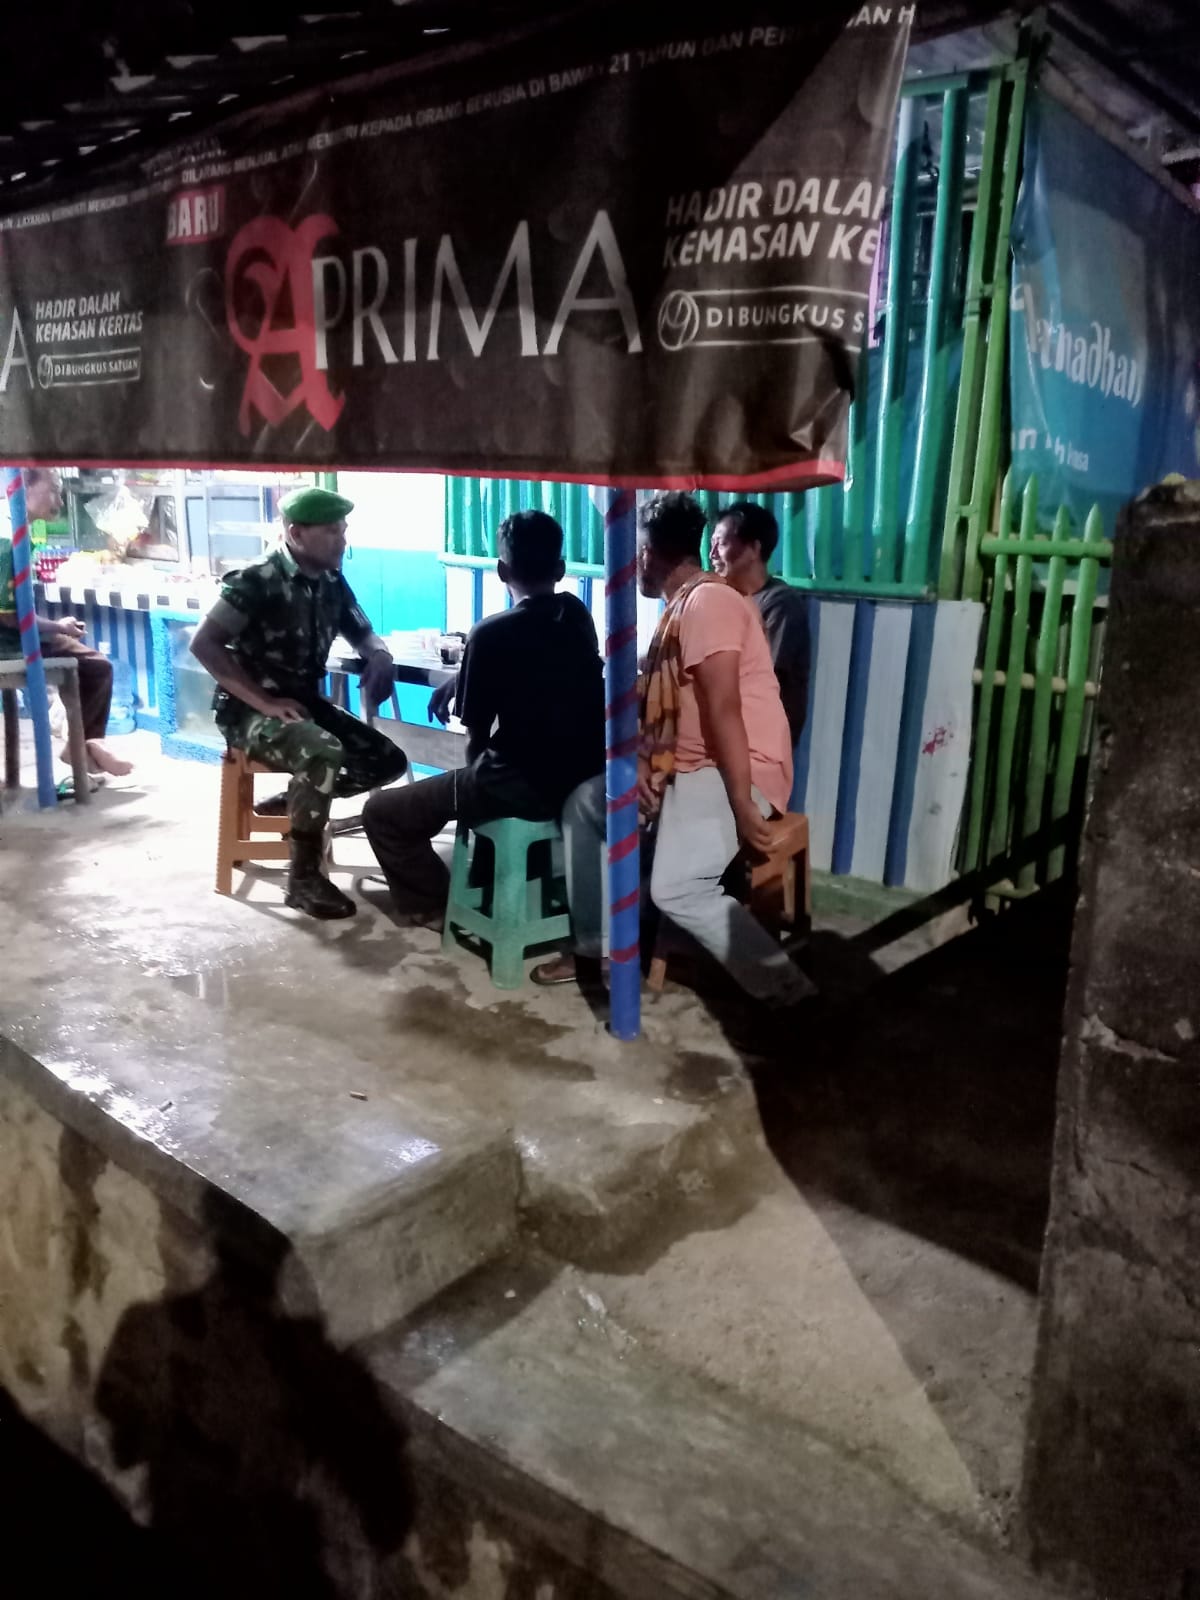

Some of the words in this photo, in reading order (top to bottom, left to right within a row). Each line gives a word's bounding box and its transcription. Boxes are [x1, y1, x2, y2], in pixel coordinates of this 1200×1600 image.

[360, 113, 413, 137] KEPADA
[529, 77, 546, 98] DI
[609, 52, 631, 74] 21
[168, 191, 219, 240] BARU
[666, 181, 763, 225] HADIR
[662, 221, 821, 268] KEMASAN
[35, 297, 77, 320] HADIR
[79, 290, 120, 317] DALAM
[705, 304, 846, 330] DIBUNGKUS
[35, 318, 97, 343] KEMASAN
[98, 311, 143, 337] KERTAS
[54, 363, 107, 377] DIBUNGKUS
[108, 359, 138, 373] SATUAN
